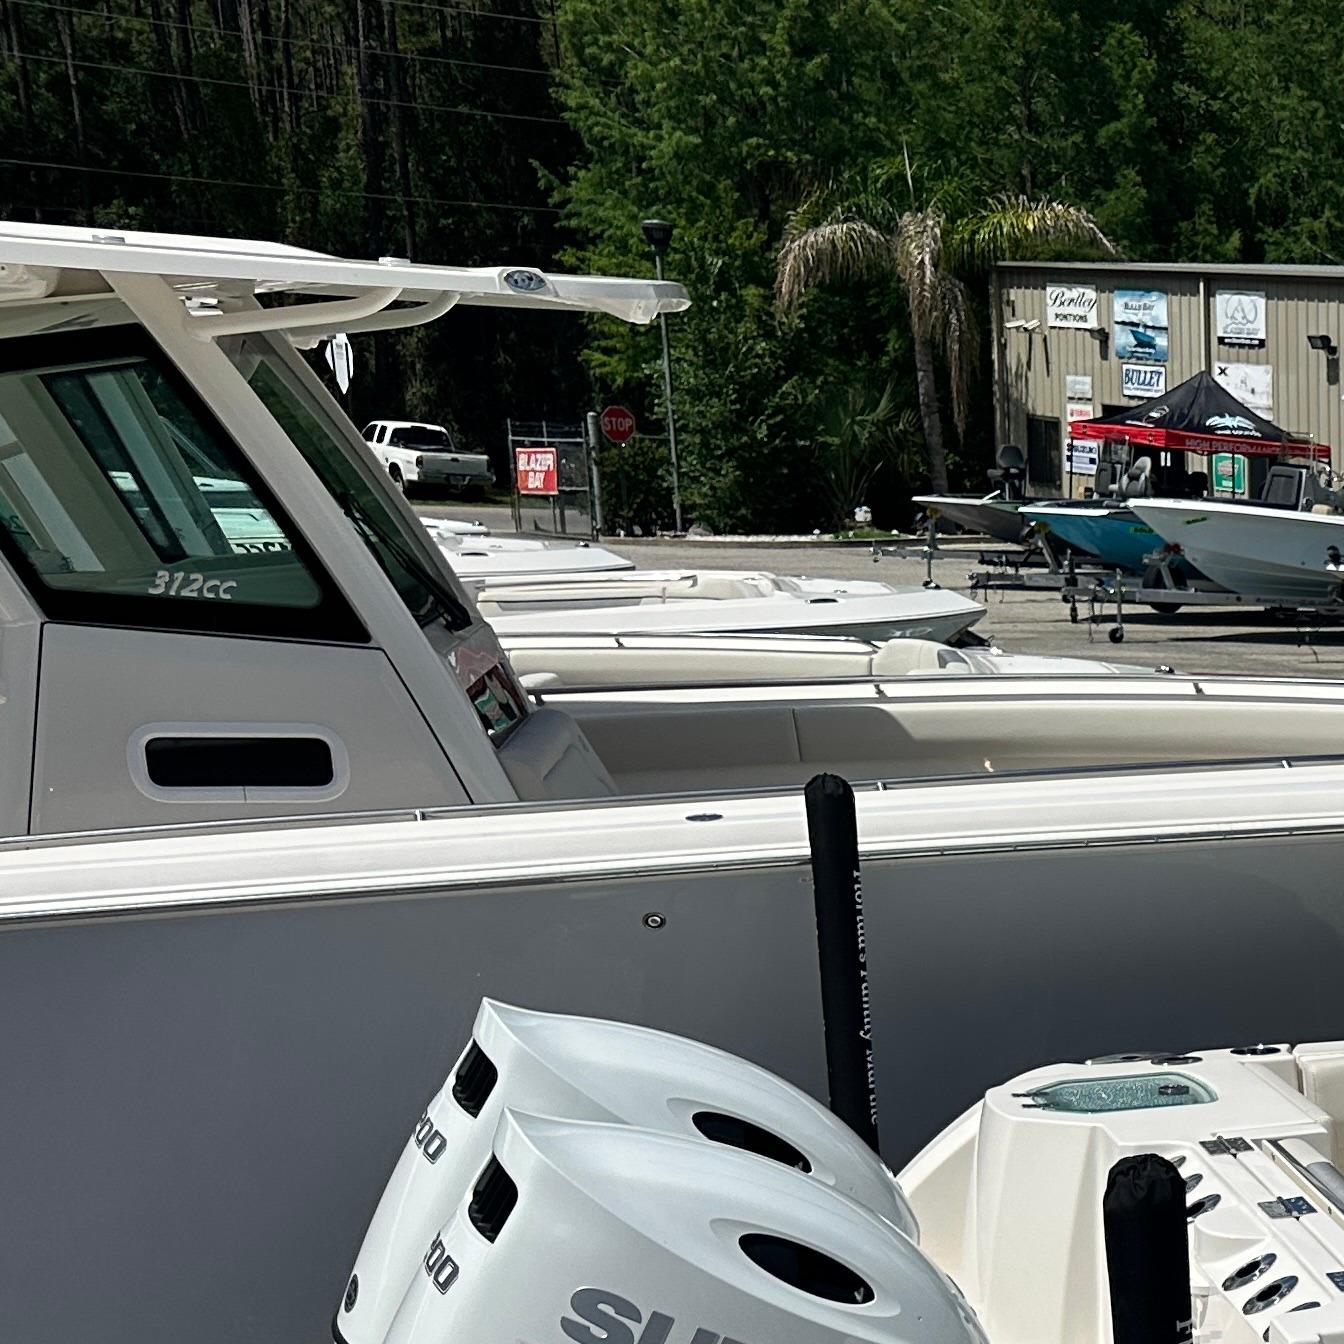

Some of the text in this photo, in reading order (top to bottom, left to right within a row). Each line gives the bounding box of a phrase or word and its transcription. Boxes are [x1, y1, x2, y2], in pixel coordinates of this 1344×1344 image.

[1124, 368, 1163, 387] BULLET
[603, 417, 633, 433] STOP
[518, 453, 554, 472] BLAZER
[527, 471, 546, 488] BAY
